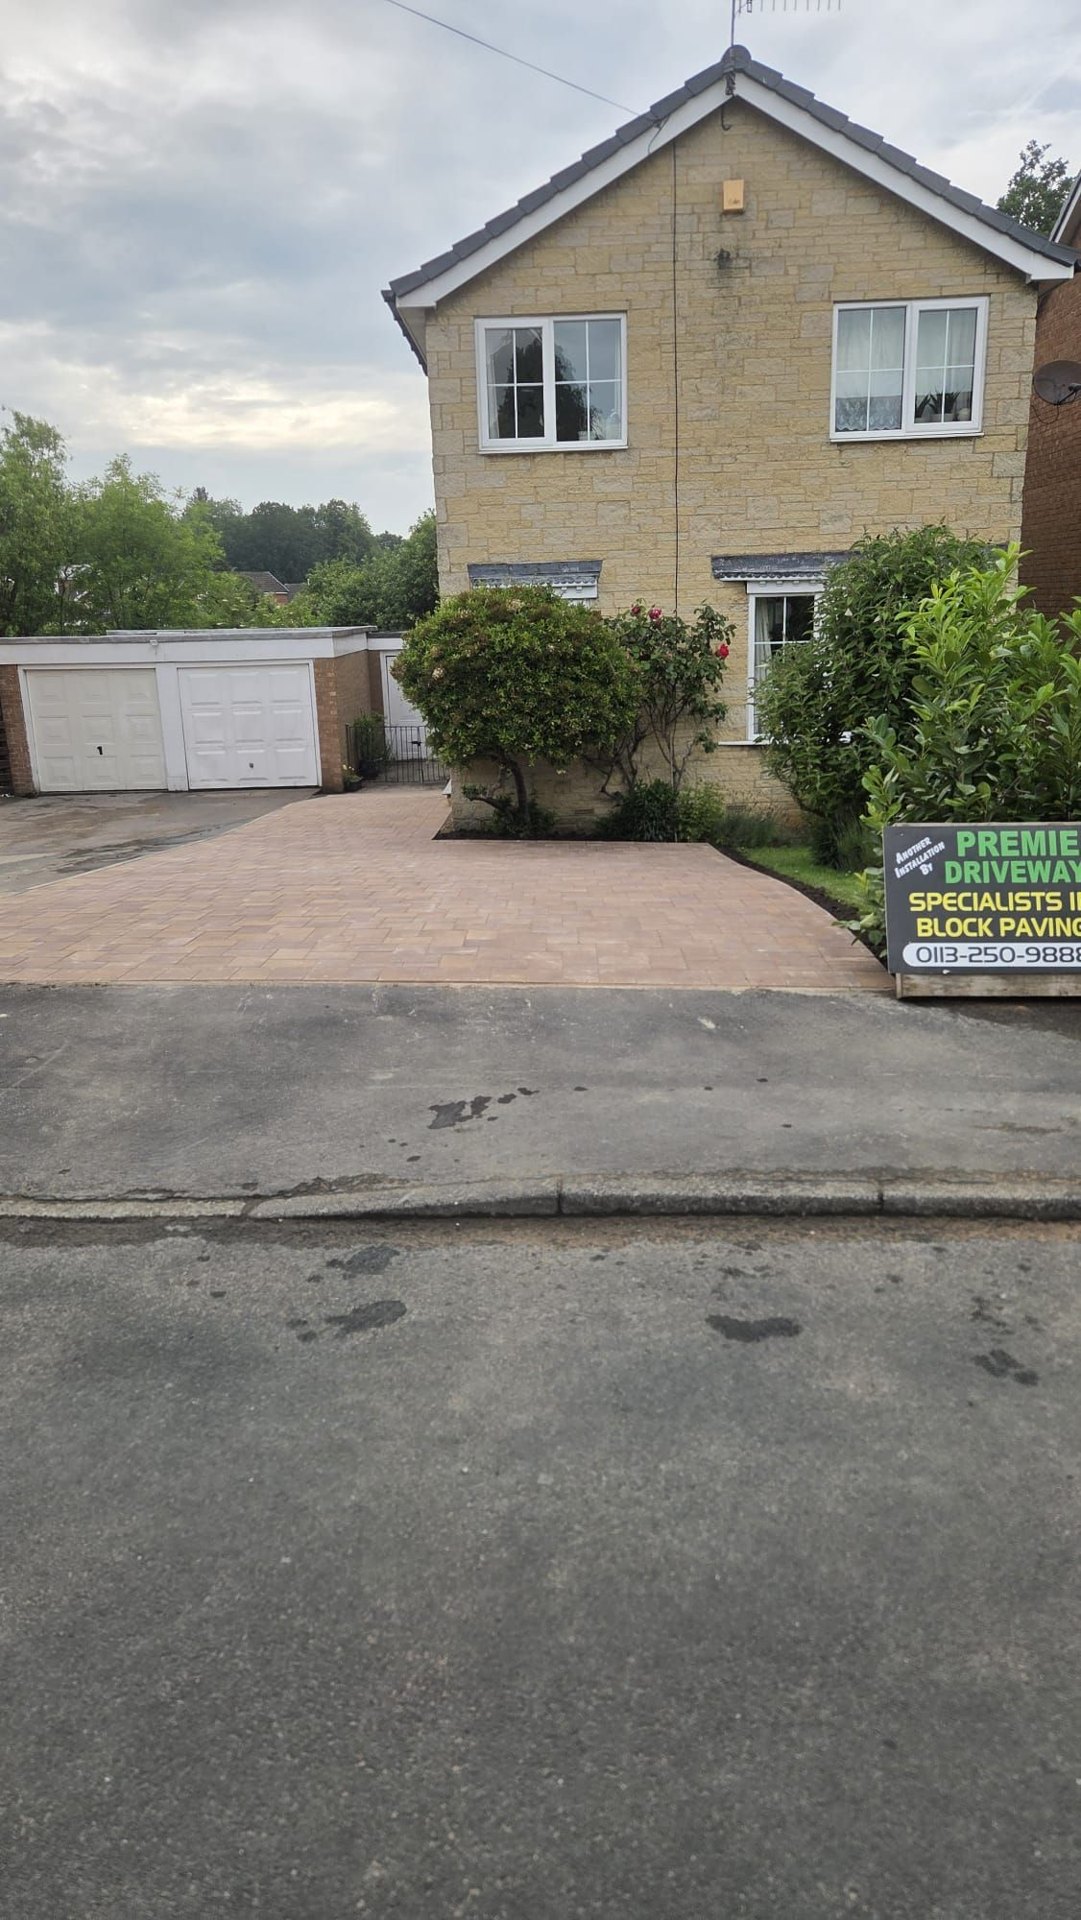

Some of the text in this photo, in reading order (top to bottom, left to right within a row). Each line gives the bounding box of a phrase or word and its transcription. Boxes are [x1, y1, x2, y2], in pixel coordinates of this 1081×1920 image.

[957, 830, 1080, 857] PREMIE
[908, 891, 1081, 912] SPECIALISTS I
[916, 917, 994, 938] BLOCK
